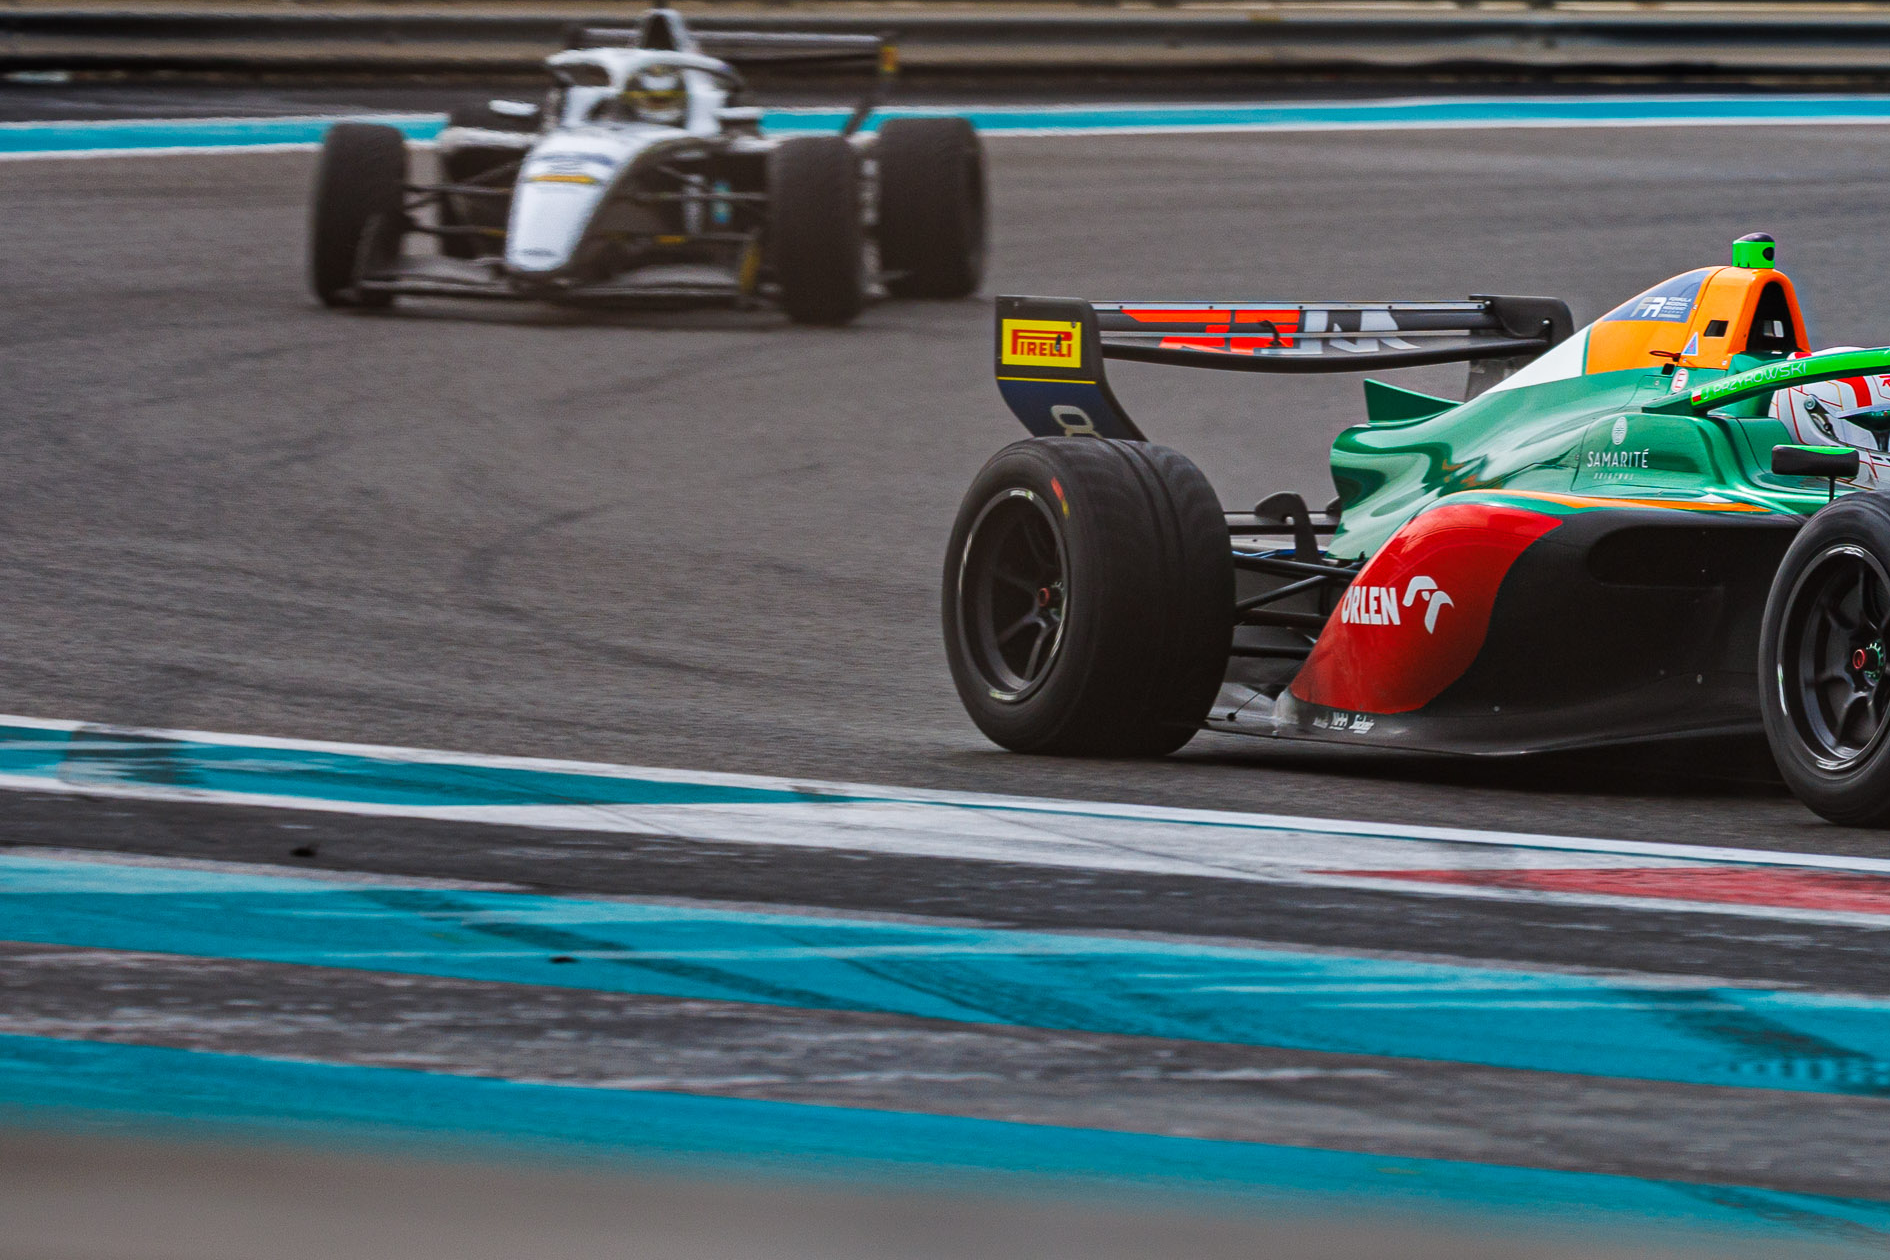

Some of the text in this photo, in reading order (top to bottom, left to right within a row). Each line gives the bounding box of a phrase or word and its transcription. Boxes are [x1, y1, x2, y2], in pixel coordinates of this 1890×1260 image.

[1011, 329, 1073, 358] PIRELLI
[1587, 448, 1650, 468] SAMARITÉ
[1341, 585, 1401, 626] ORLEN
